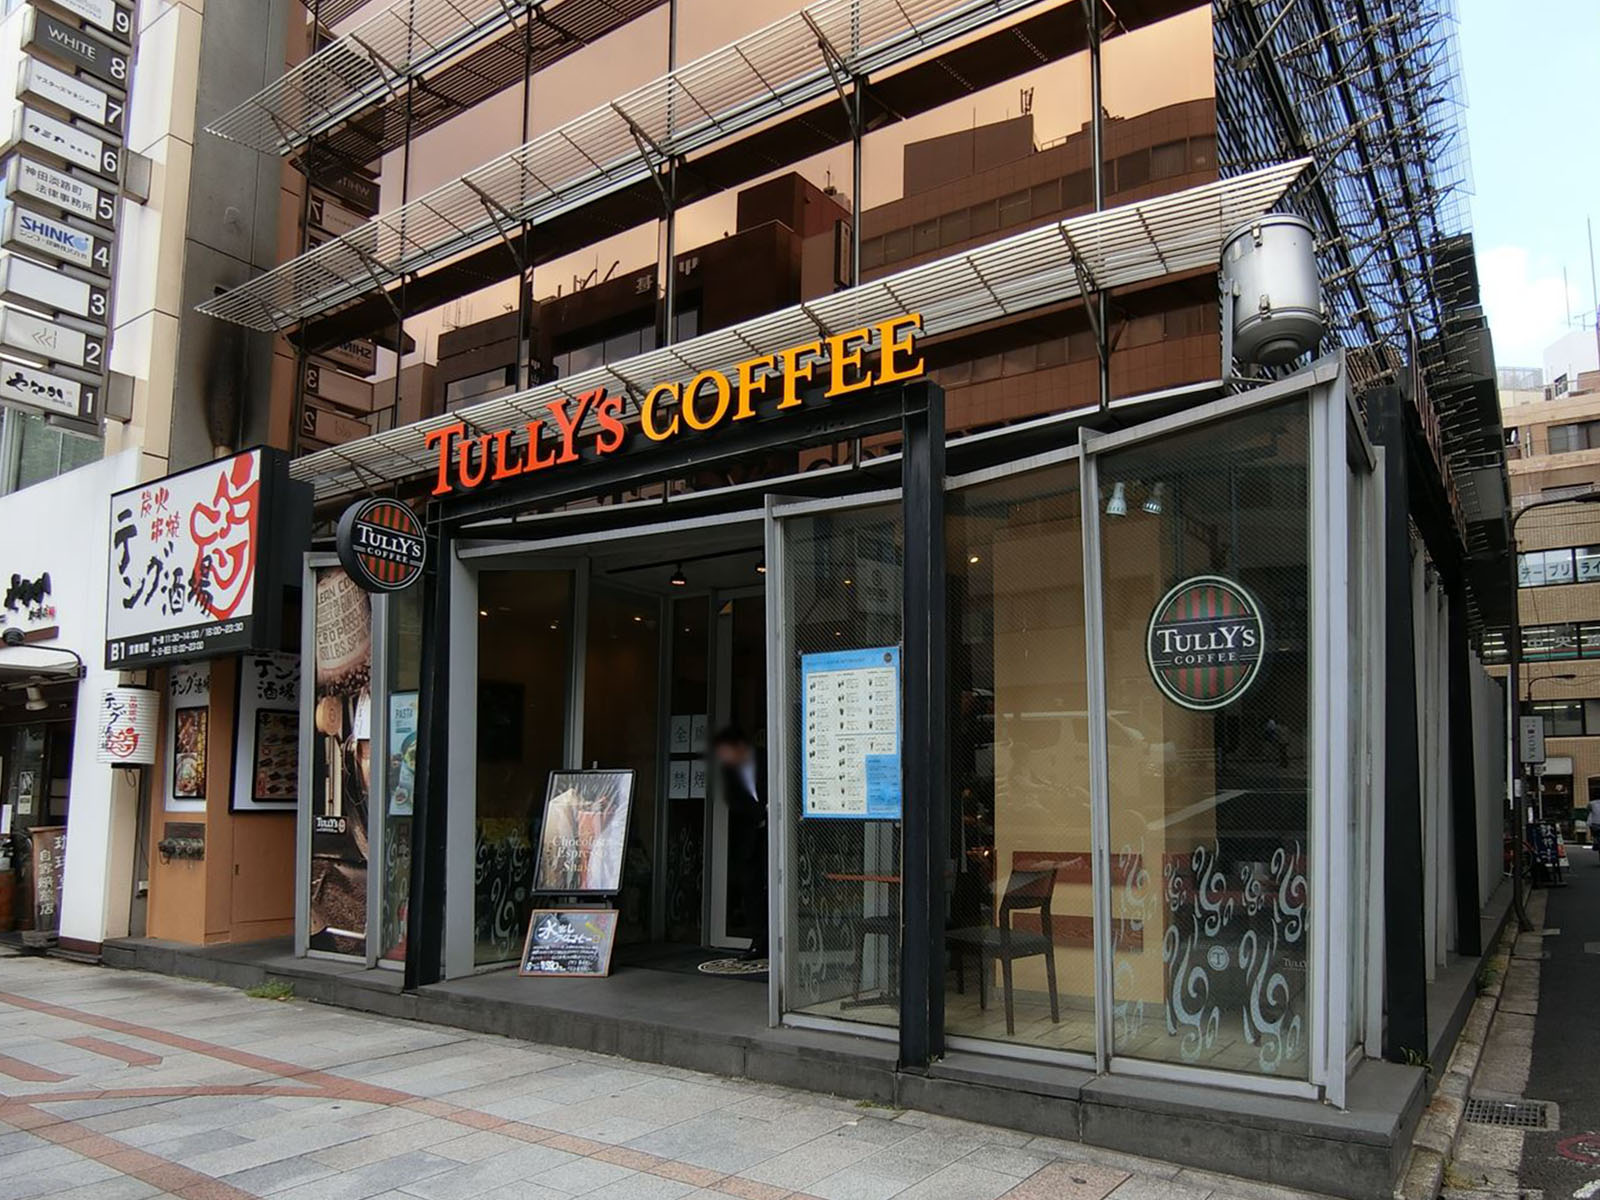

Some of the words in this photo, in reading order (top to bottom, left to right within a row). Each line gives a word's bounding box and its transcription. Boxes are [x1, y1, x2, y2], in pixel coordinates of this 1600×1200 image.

[116, 12, 130, 33] 9
[48, 25, 96, 60] WHITE
[111, 58, 125, 79] 8
[108, 102, 122, 123] 7
[103, 151, 117, 172] 6
[99, 200, 113, 220] 5
[94, 247, 109, 267] 4
[91, 294, 105, 315] 3
[86, 343, 100, 365] 2
[641, 312, 926, 442] COFFEE
[85, 393, 93, 412] 1
[367, 547, 408, 563] COFFEE
[111, 641, 126, 662] B1
[1174, 652, 1237, 665] COFFEE
